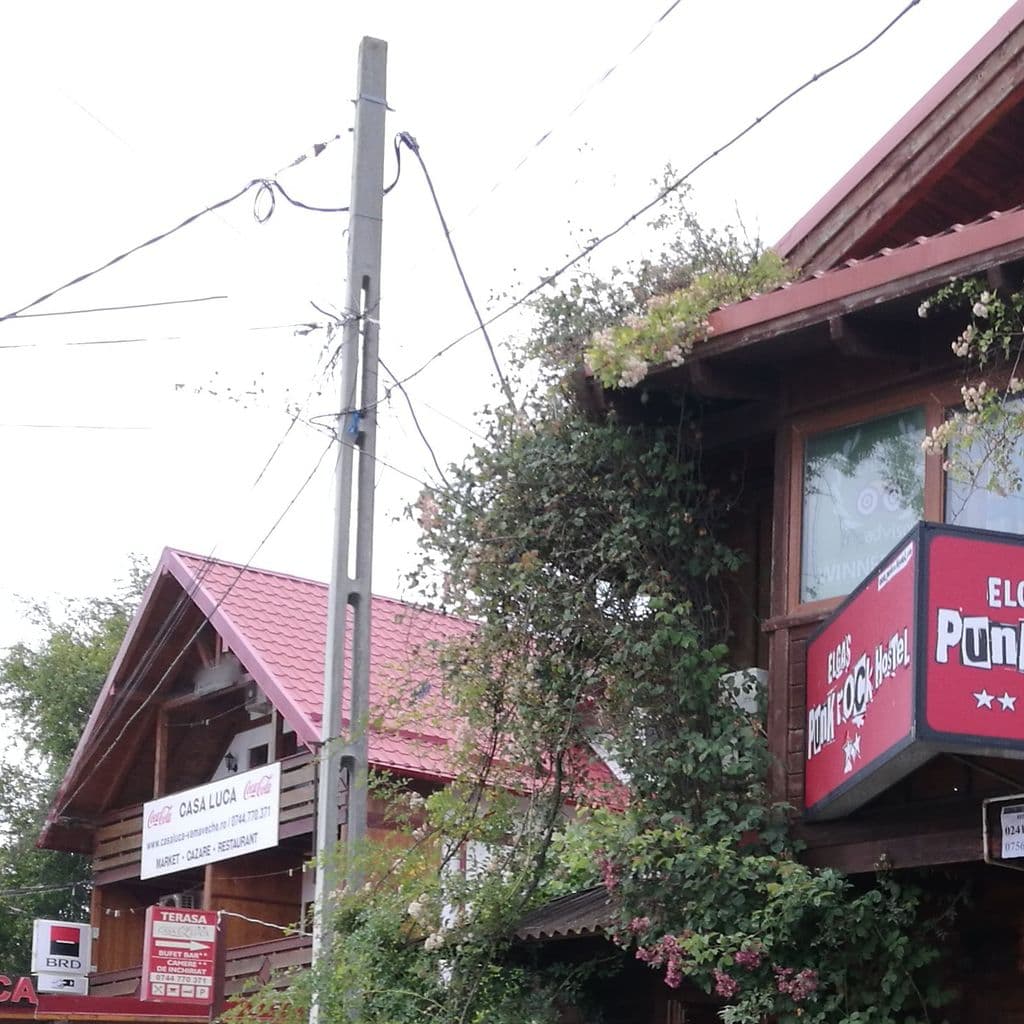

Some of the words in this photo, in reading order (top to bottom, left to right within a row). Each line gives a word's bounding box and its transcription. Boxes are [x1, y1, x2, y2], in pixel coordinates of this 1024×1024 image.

[179, 796, 206, 818] CASA
[209, 787, 237, 810] LUCA
[156, 853, 180, 869] MARKET
[186, 844, 211, 862] CAZARE
[217, 832, 258, 852] RESTAURANT
[160, 911, 207, 924] TERASA
[46, 957, 82, 969] BRD
